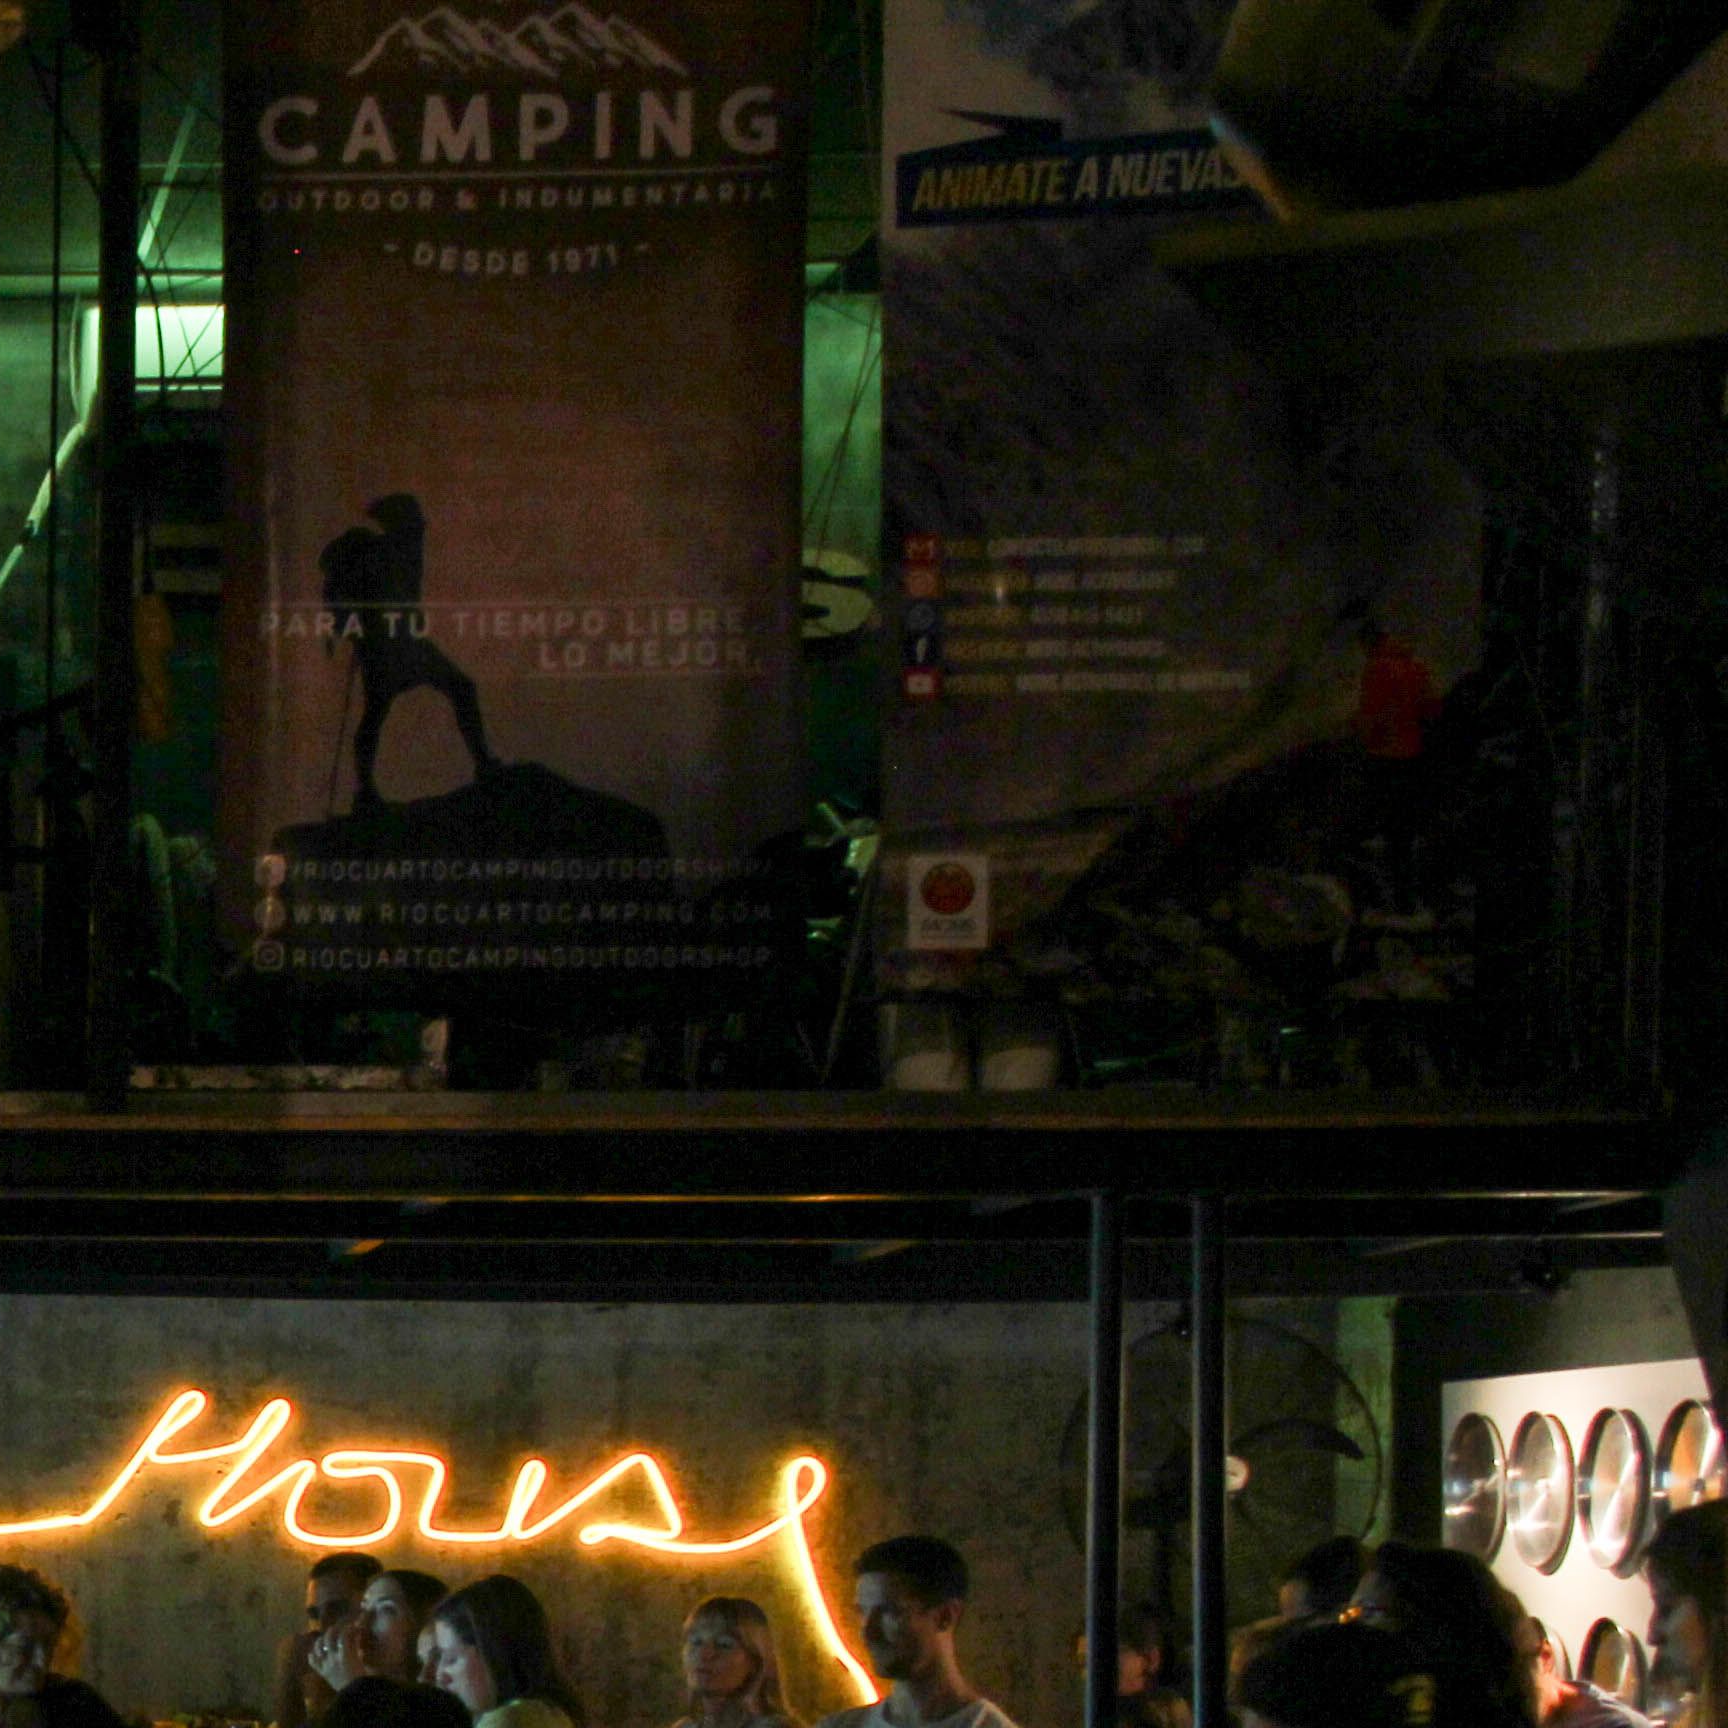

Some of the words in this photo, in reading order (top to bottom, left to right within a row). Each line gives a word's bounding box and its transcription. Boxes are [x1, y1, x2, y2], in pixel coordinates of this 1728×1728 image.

[258, 86, 779, 165] CAMPING
[1073, 155, 1100, 200] A
[259, 188, 434, 212] OUTDOOR
[499, 180, 775, 209] INDUMENTARIA
[412, 242, 529, 275] DESDE
[548, 243, 619, 274] 1971
[258, 611, 366, 639] PARA
[382, 611, 430, 639] TU
[453, 609, 609, 638] TIEMPO
[539, 642, 589, 670] LO
